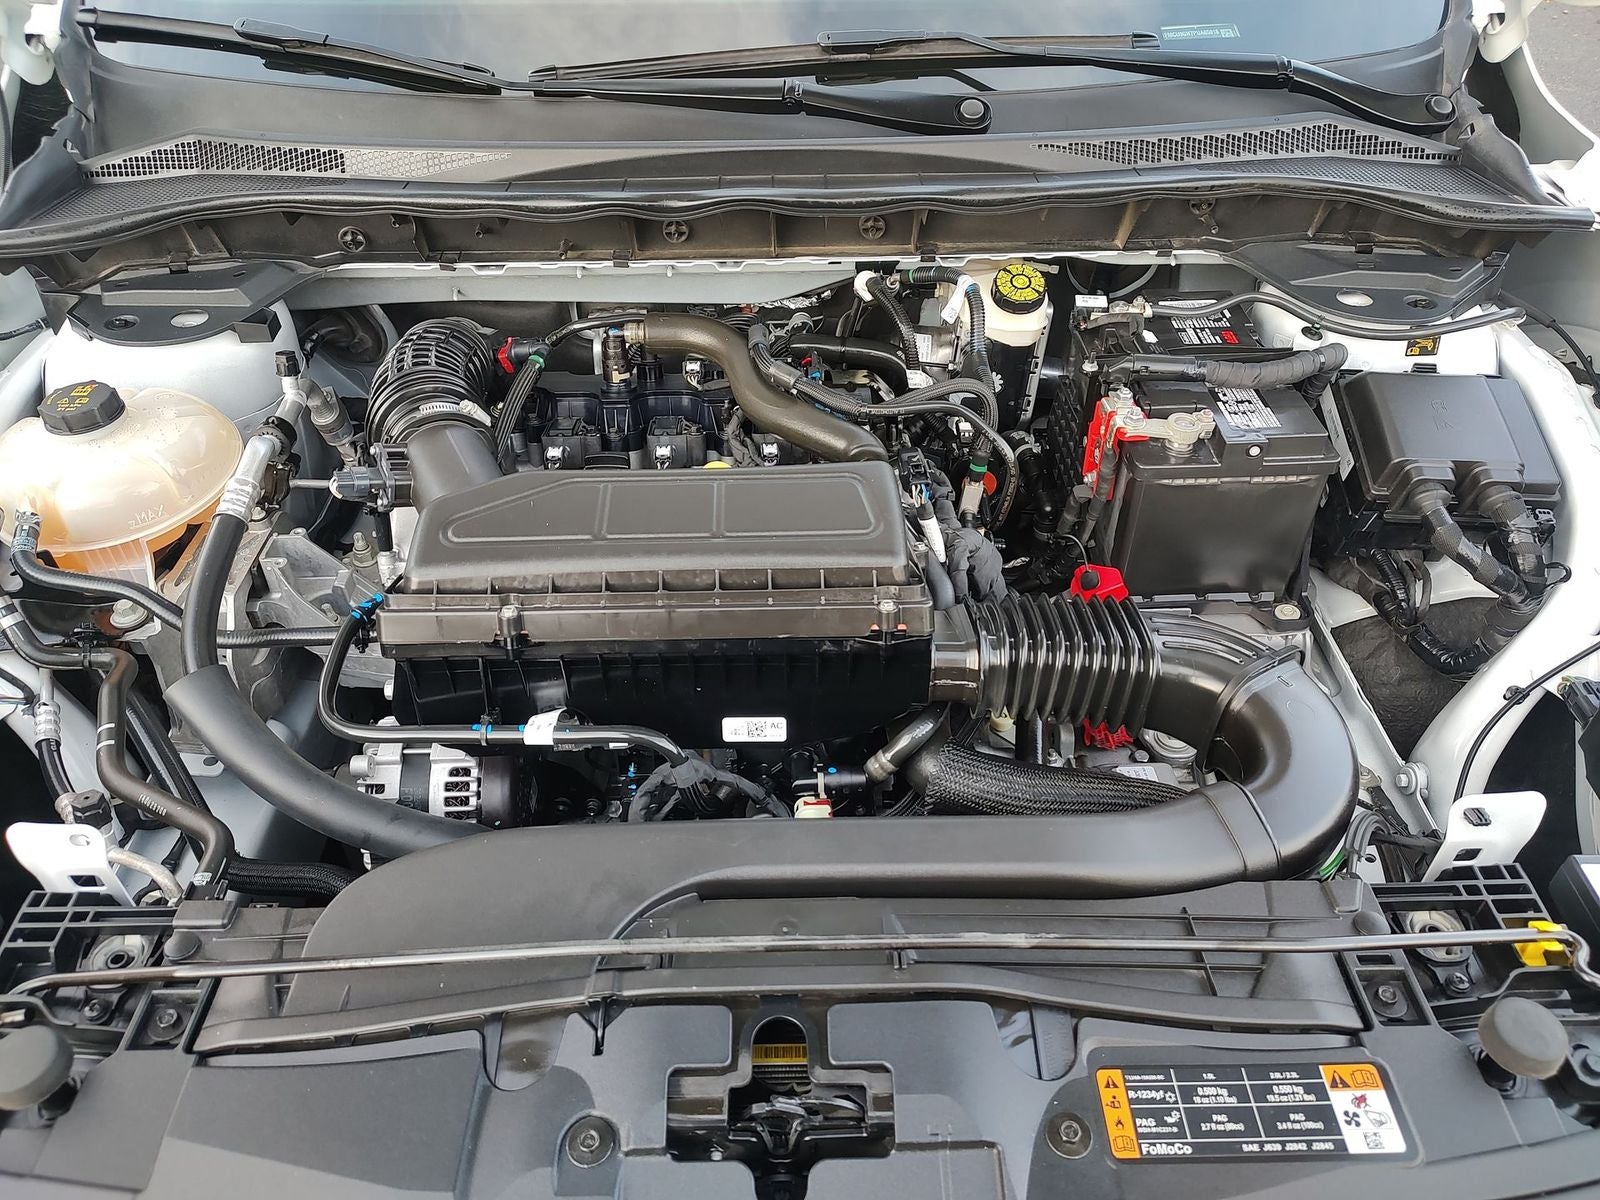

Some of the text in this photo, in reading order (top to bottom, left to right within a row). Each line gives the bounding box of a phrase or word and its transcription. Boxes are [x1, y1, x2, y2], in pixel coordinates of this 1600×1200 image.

[136, 504, 164, 524] MAX
[1217, 1087, 1229, 1096] kg
[1293, 1085, 1304, 1094] kg
[1128, 1090, 1164, 1100] R-1234yf
[1136, 1118, 1156, 1126] PAG
[1212, 1114, 1228, 1122] PAG
[1141, 1143, 1192, 1155] FoMoCo
[1242, 1143, 1261, 1152] SAE
